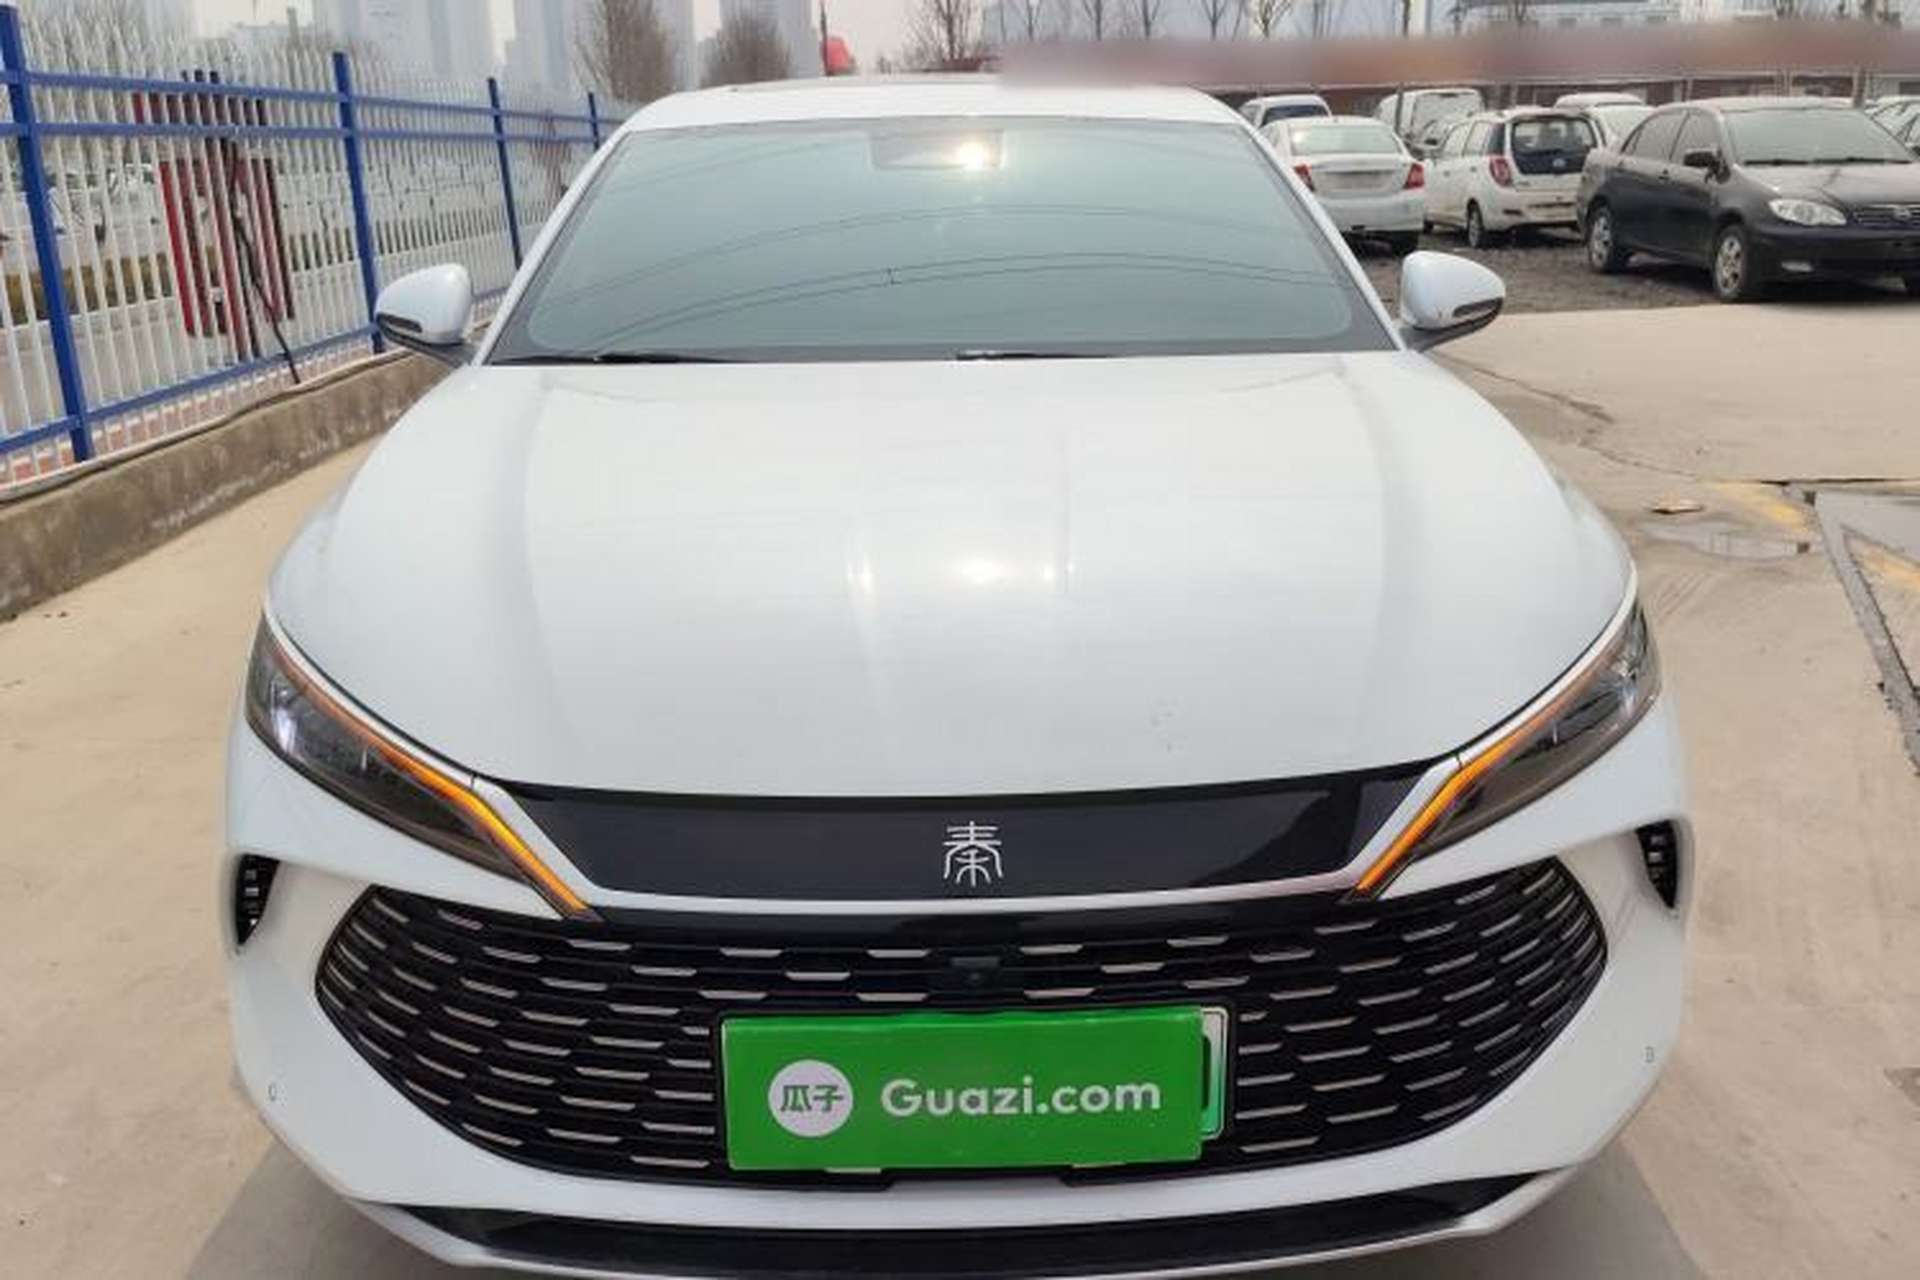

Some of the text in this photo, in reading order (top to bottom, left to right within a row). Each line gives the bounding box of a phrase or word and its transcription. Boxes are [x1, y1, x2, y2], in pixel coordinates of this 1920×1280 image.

[942, 820, 1003, 887] 秦
[780, 1084, 845, 1114] 瓜子
[881, 1075, 1161, 1117] Guazi.com
